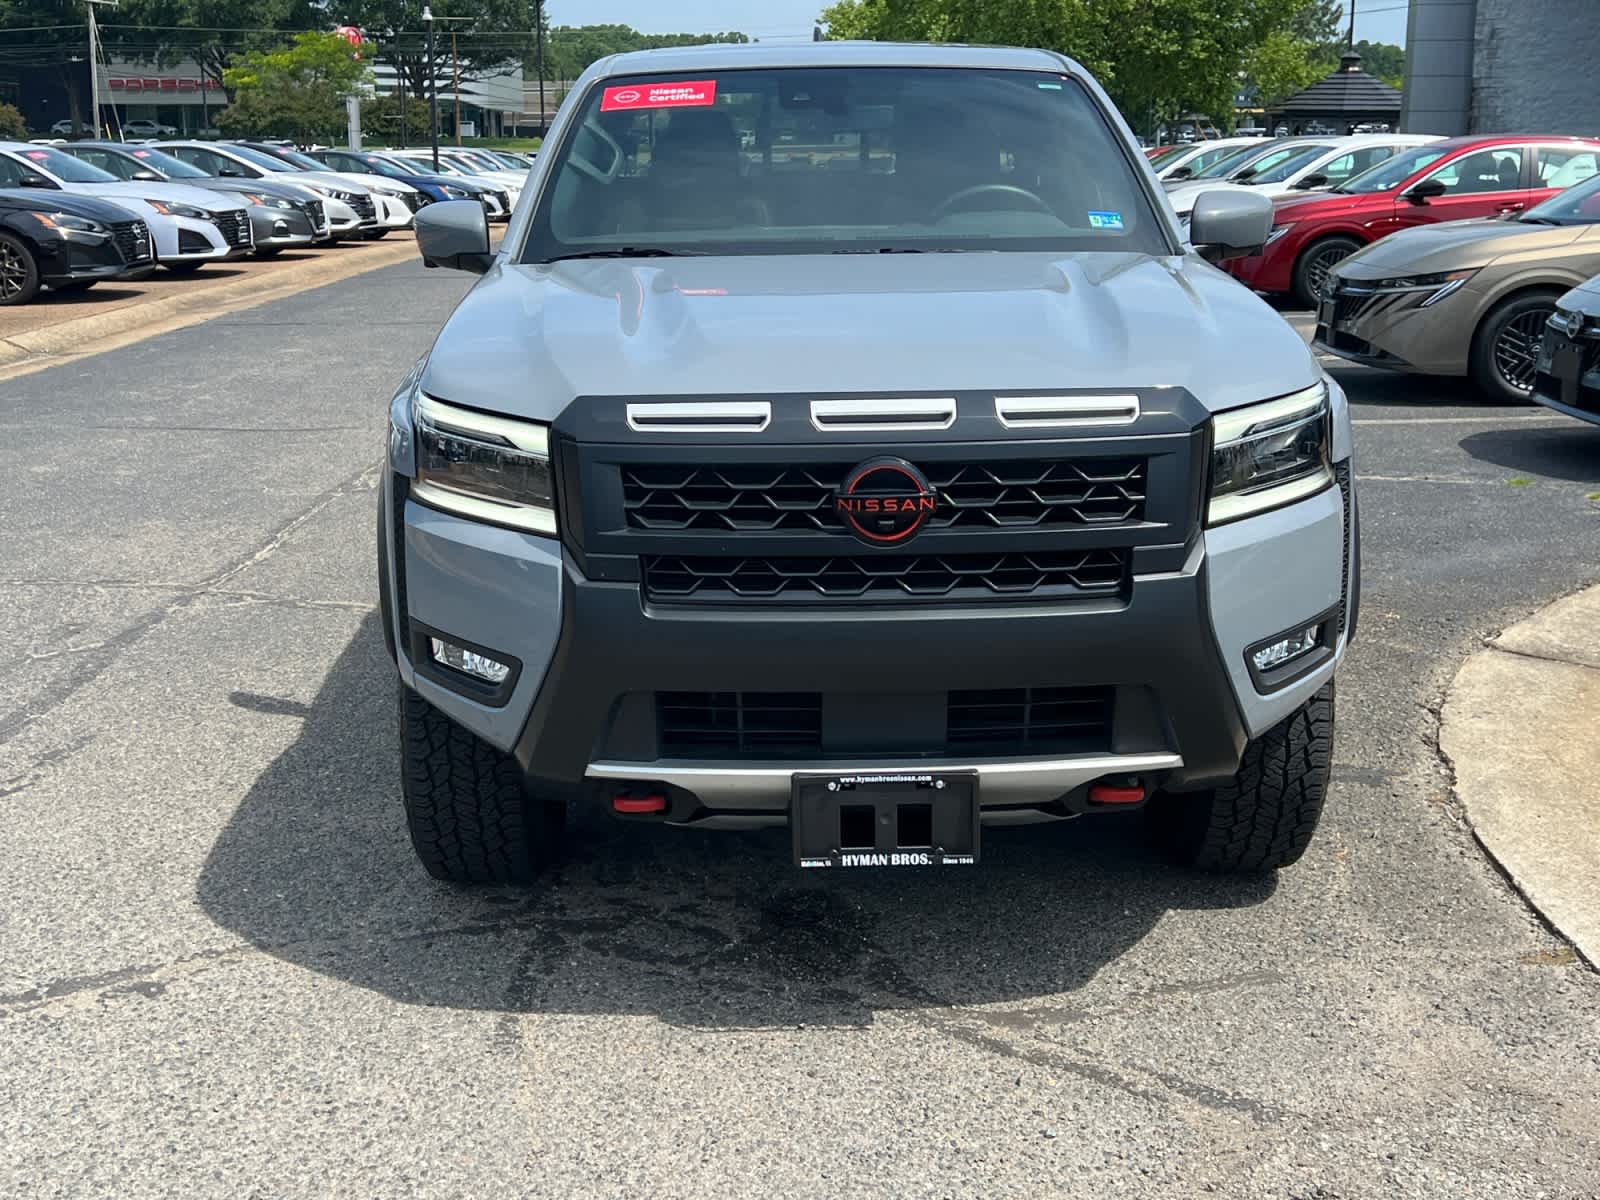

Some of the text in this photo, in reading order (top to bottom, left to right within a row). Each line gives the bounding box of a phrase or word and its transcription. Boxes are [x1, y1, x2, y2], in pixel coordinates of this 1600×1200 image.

[648, 93, 705, 102] Certified
[837, 497, 935, 512] NISSAN
[842, 853, 888, 867] HYMAN
[891, 852, 933, 866] BROS.
